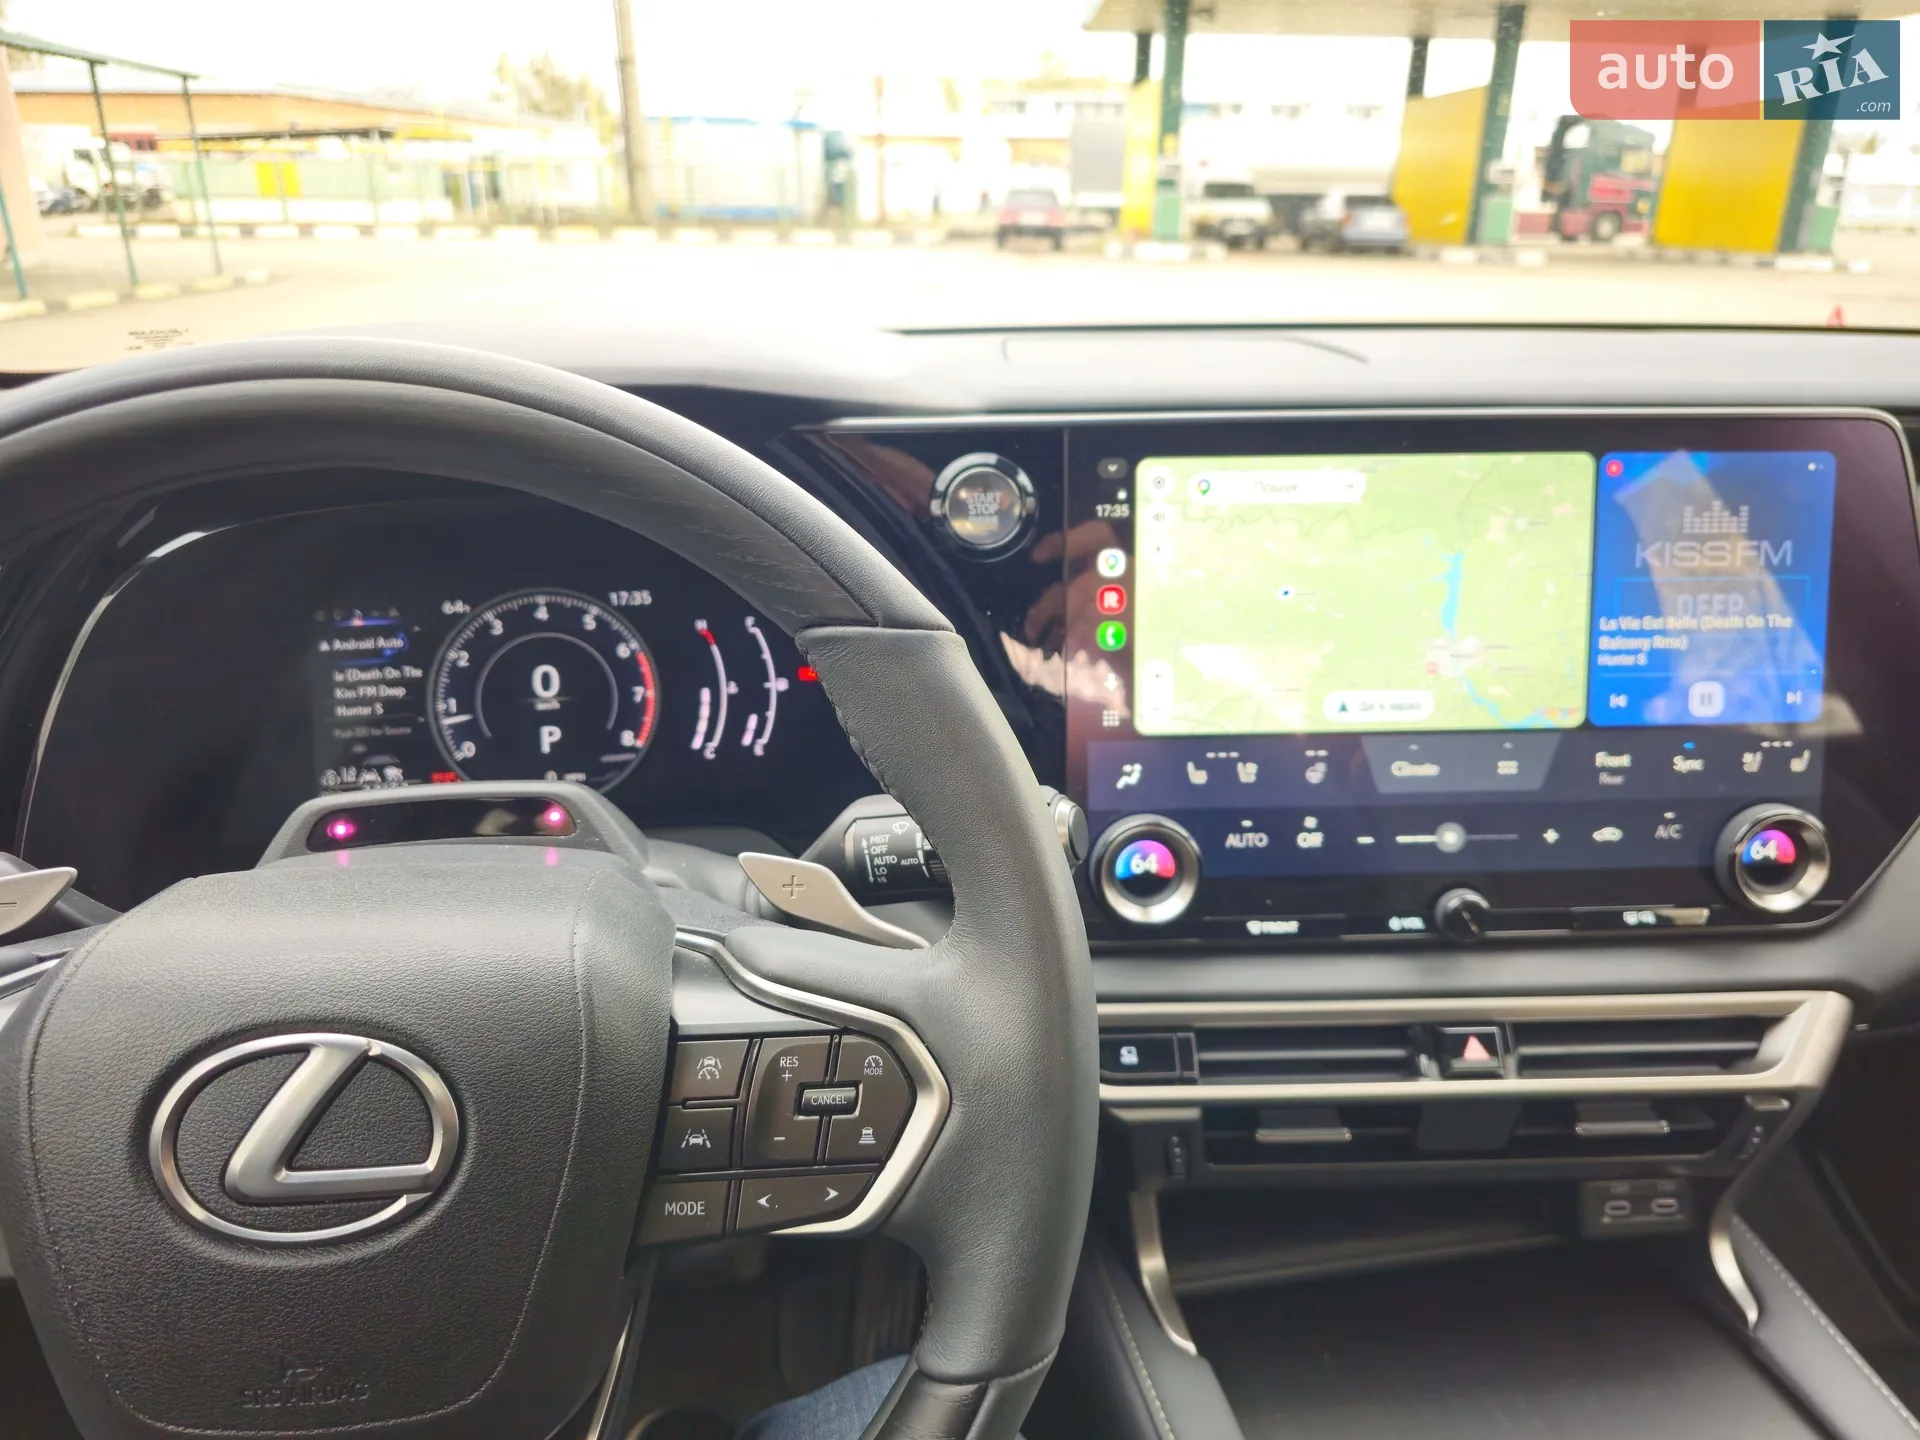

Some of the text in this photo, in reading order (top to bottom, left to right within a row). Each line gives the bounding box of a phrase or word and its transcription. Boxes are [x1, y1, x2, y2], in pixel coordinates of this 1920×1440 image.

[968, 504, 999, 515] STOP
[1095, 503, 1130, 519] 17:35
[608, 590, 652, 606] 17:35
[533, 605, 549, 621] 4
[1767, 612, 1793, 628] The
[489, 618, 503, 635] 3
[582, 613, 597, 631] 5
[332, 636, 404, 651] Android Auto
[616, 641, 631, 659] 6
[455, 651, 470, 667] 2
[382, 666, 401, 679] On
[402, 665, 423, 678] The
[532, 664, 560, 699] 0
[334, 685, 406, 699] Kiss FM Deep
[631, 686, 645, 703] 7
[334, 702, 384, 716] Hunter S
[447, 697, 457, 713] 1
[539, 725, 562, 754] P
[461, 741, 476, 758] 0
[1673, 755, 1705, 773] Sync
[870, 834, 890, 844] MIST
[1654, 823, 1683, 840] A/C
[1225, 832, 1269, 848] AUTO
[871, 845, 888, 855] OFF
[1750, 839, 1778, 861] 64
[874, 855, 898, 866] AUTO
[901, 857, 919, 866] AUTO
[1130, 852, 1159, 875] 64
[875, 867, 887, 875] LO
[780, 1056, 799, 1067] RES
[864, 1067, 884, 1076] MODE
[811, 1094, 847, 1106] CANCEL
[665, 1201, 706, 1216] MODE
